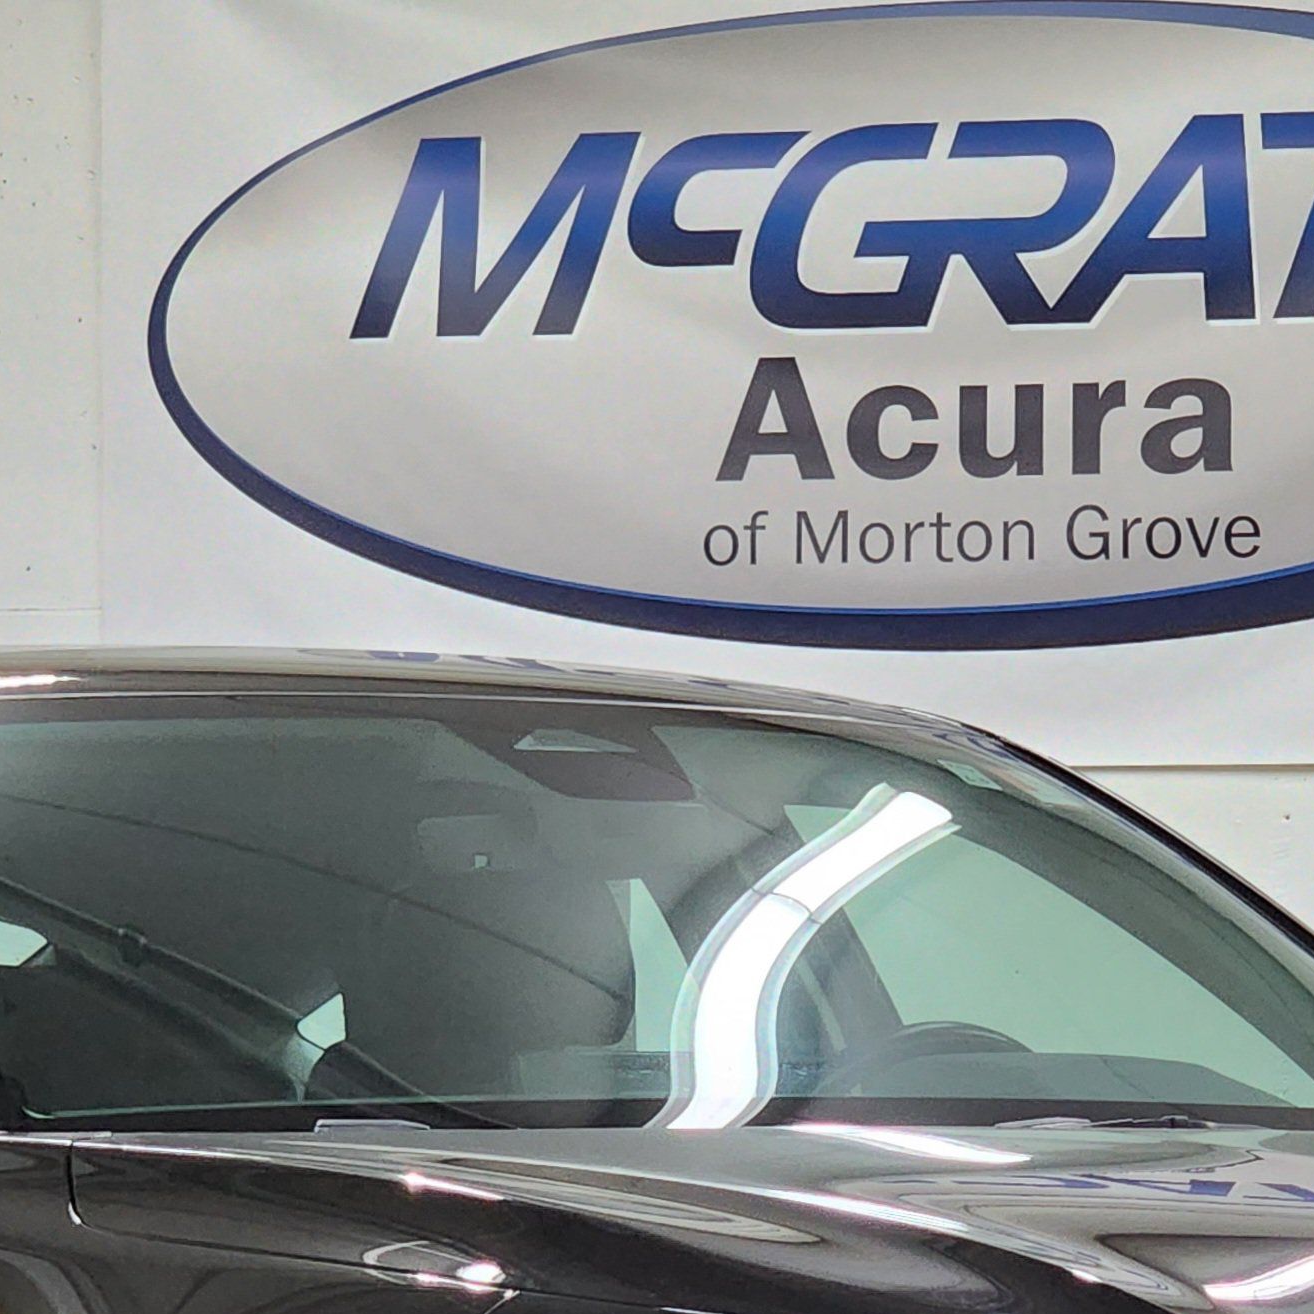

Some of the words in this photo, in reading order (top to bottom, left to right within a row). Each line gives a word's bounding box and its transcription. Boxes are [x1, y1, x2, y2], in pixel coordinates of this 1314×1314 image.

[715, 356, 1234, 482] Acura
[703, 510, 769, 567] of
[794, 510, 1036, 565] Morton
[1065, 503, 1262, 561] Grove
